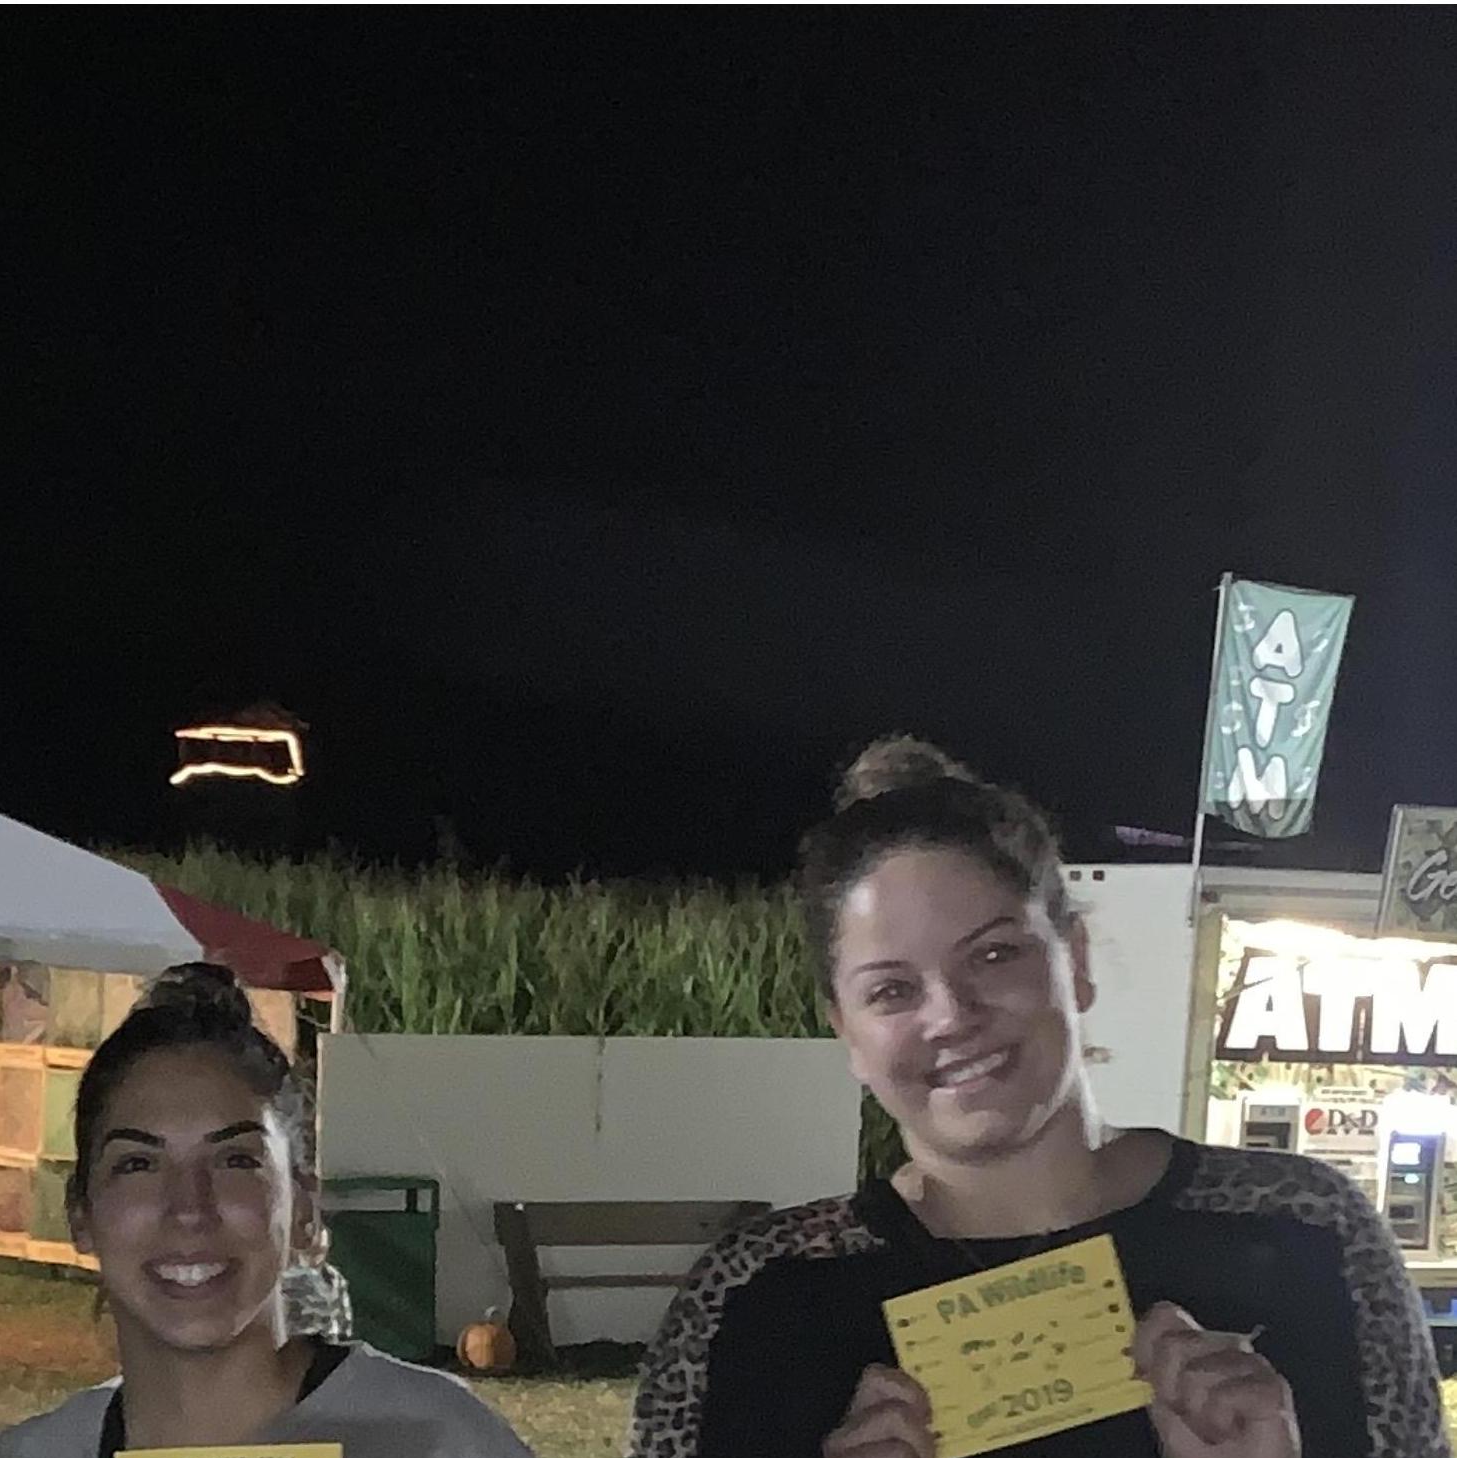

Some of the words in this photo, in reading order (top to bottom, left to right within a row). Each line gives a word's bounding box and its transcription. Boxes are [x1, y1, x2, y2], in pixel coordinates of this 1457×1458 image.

[1227, 609, 1304, 821] ATM
[1218, 949, 1457, 1057] ATM
[936, 1292, 980, 1324] PA
[1002, 1378, 1075, 1419] 2019
